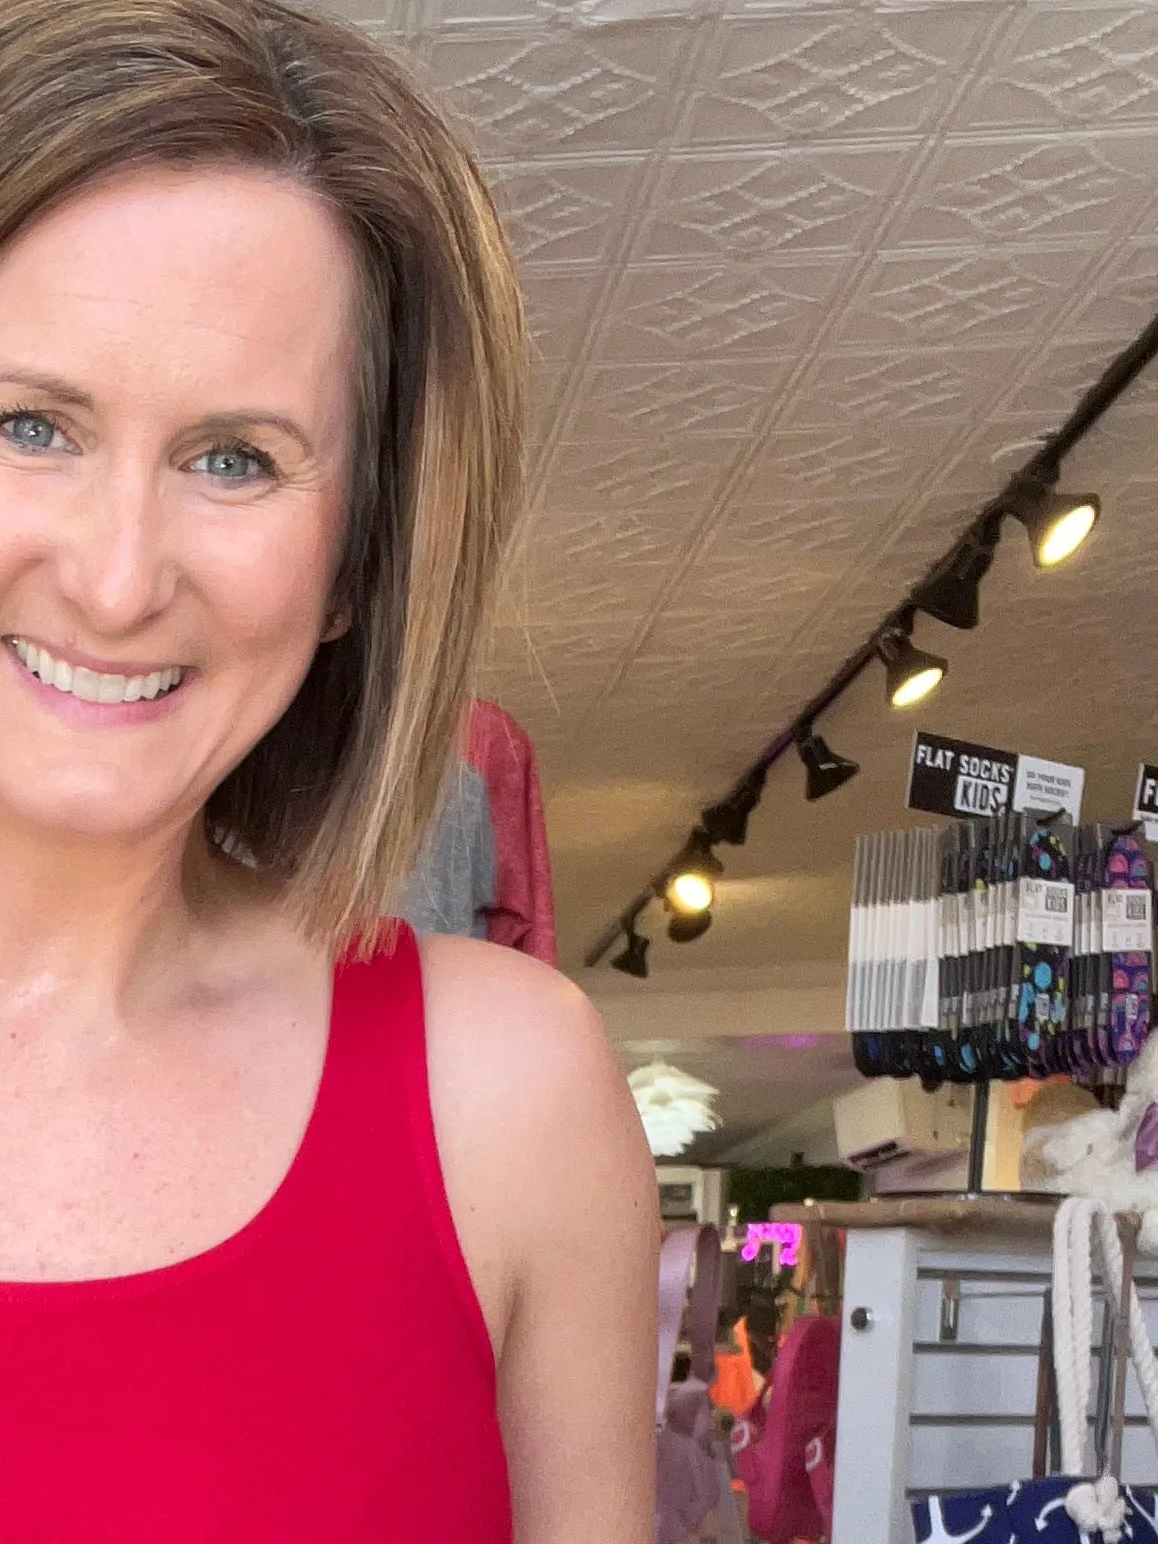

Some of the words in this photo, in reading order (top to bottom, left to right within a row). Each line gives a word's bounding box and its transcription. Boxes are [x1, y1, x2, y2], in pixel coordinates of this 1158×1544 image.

[916, 744, 955, 771] FLAT
[959, 754, 1011, 783] SOCKS
[960, 779, 1001, 813] KIDS
